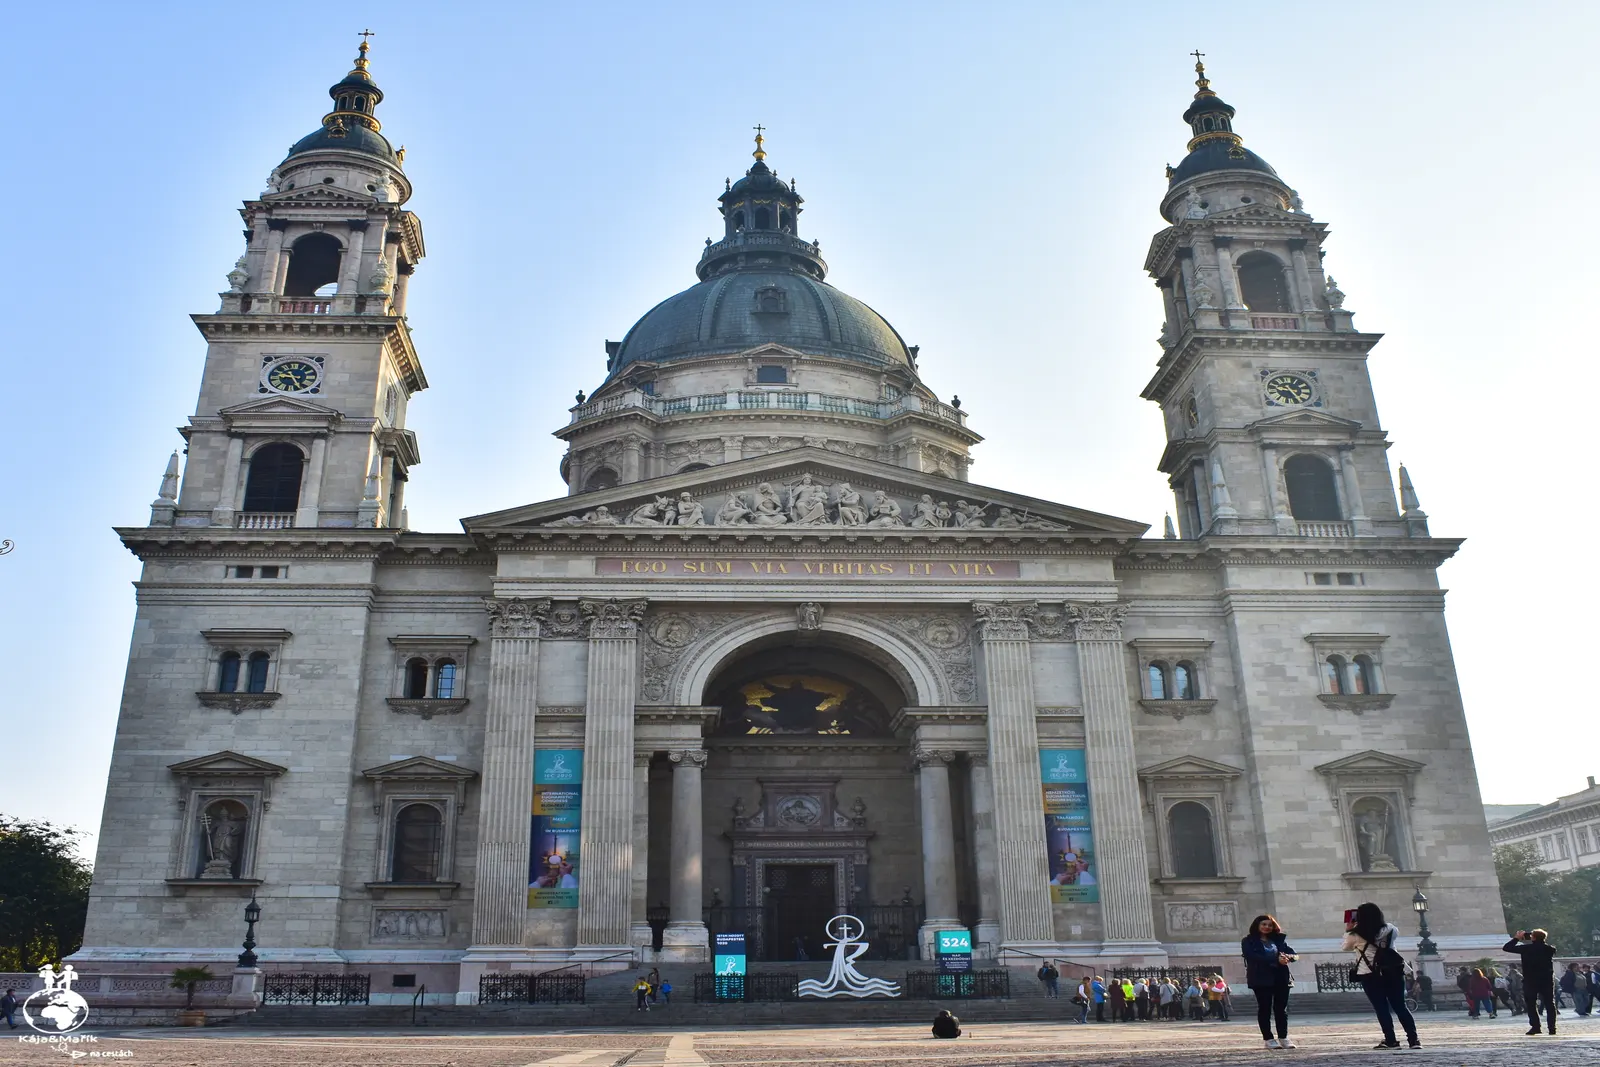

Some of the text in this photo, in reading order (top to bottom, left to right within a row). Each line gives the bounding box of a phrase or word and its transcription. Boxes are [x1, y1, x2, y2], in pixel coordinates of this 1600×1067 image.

[621, 561, 995, 575] EGO SUM VIA VERITAS ET VITA
[942, 937, 969, 948] 324
